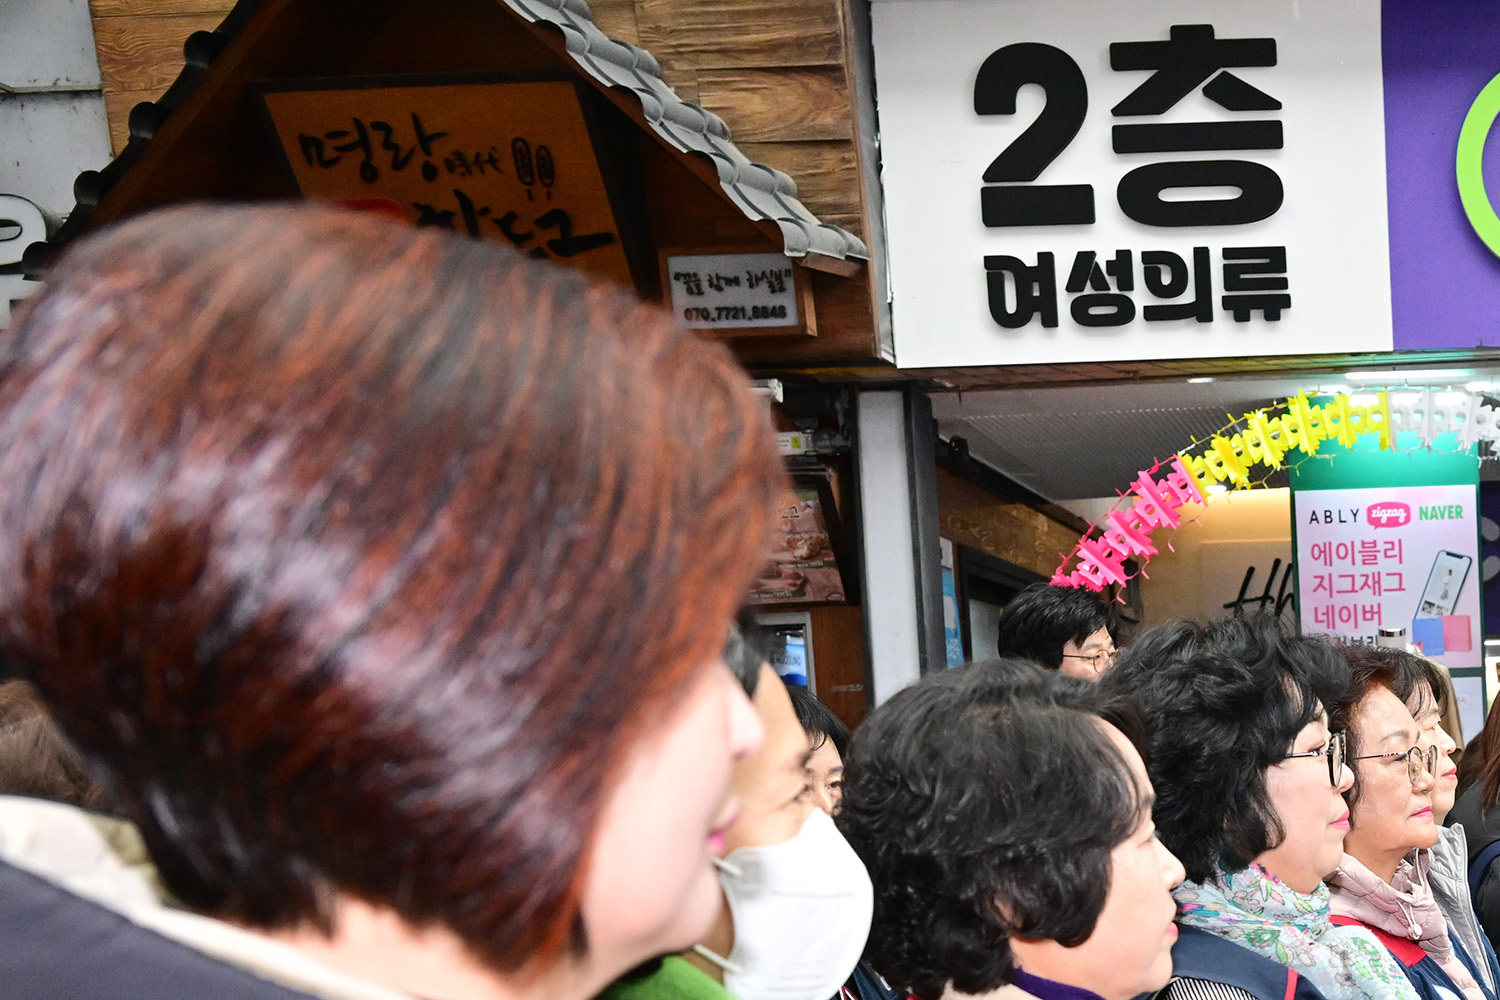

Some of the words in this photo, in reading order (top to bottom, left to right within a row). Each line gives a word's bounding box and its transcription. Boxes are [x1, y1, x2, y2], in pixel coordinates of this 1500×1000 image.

[974, 24, 1284, 228] 2층
[300, 111, 447, 183] 명랑
[984, 245, 1292, 329] 여성의류
[1309, 508, 1359, 525] ABLY
[1370, 506, 1407, 524] zigzag
[1419, 504, 1464, 521] NAVER
[1311, 538, 1404, 567] 에이블리
[1312, 571, 1406, 598] 지그재그
[1314, 602, 1383, 630] 네이버
